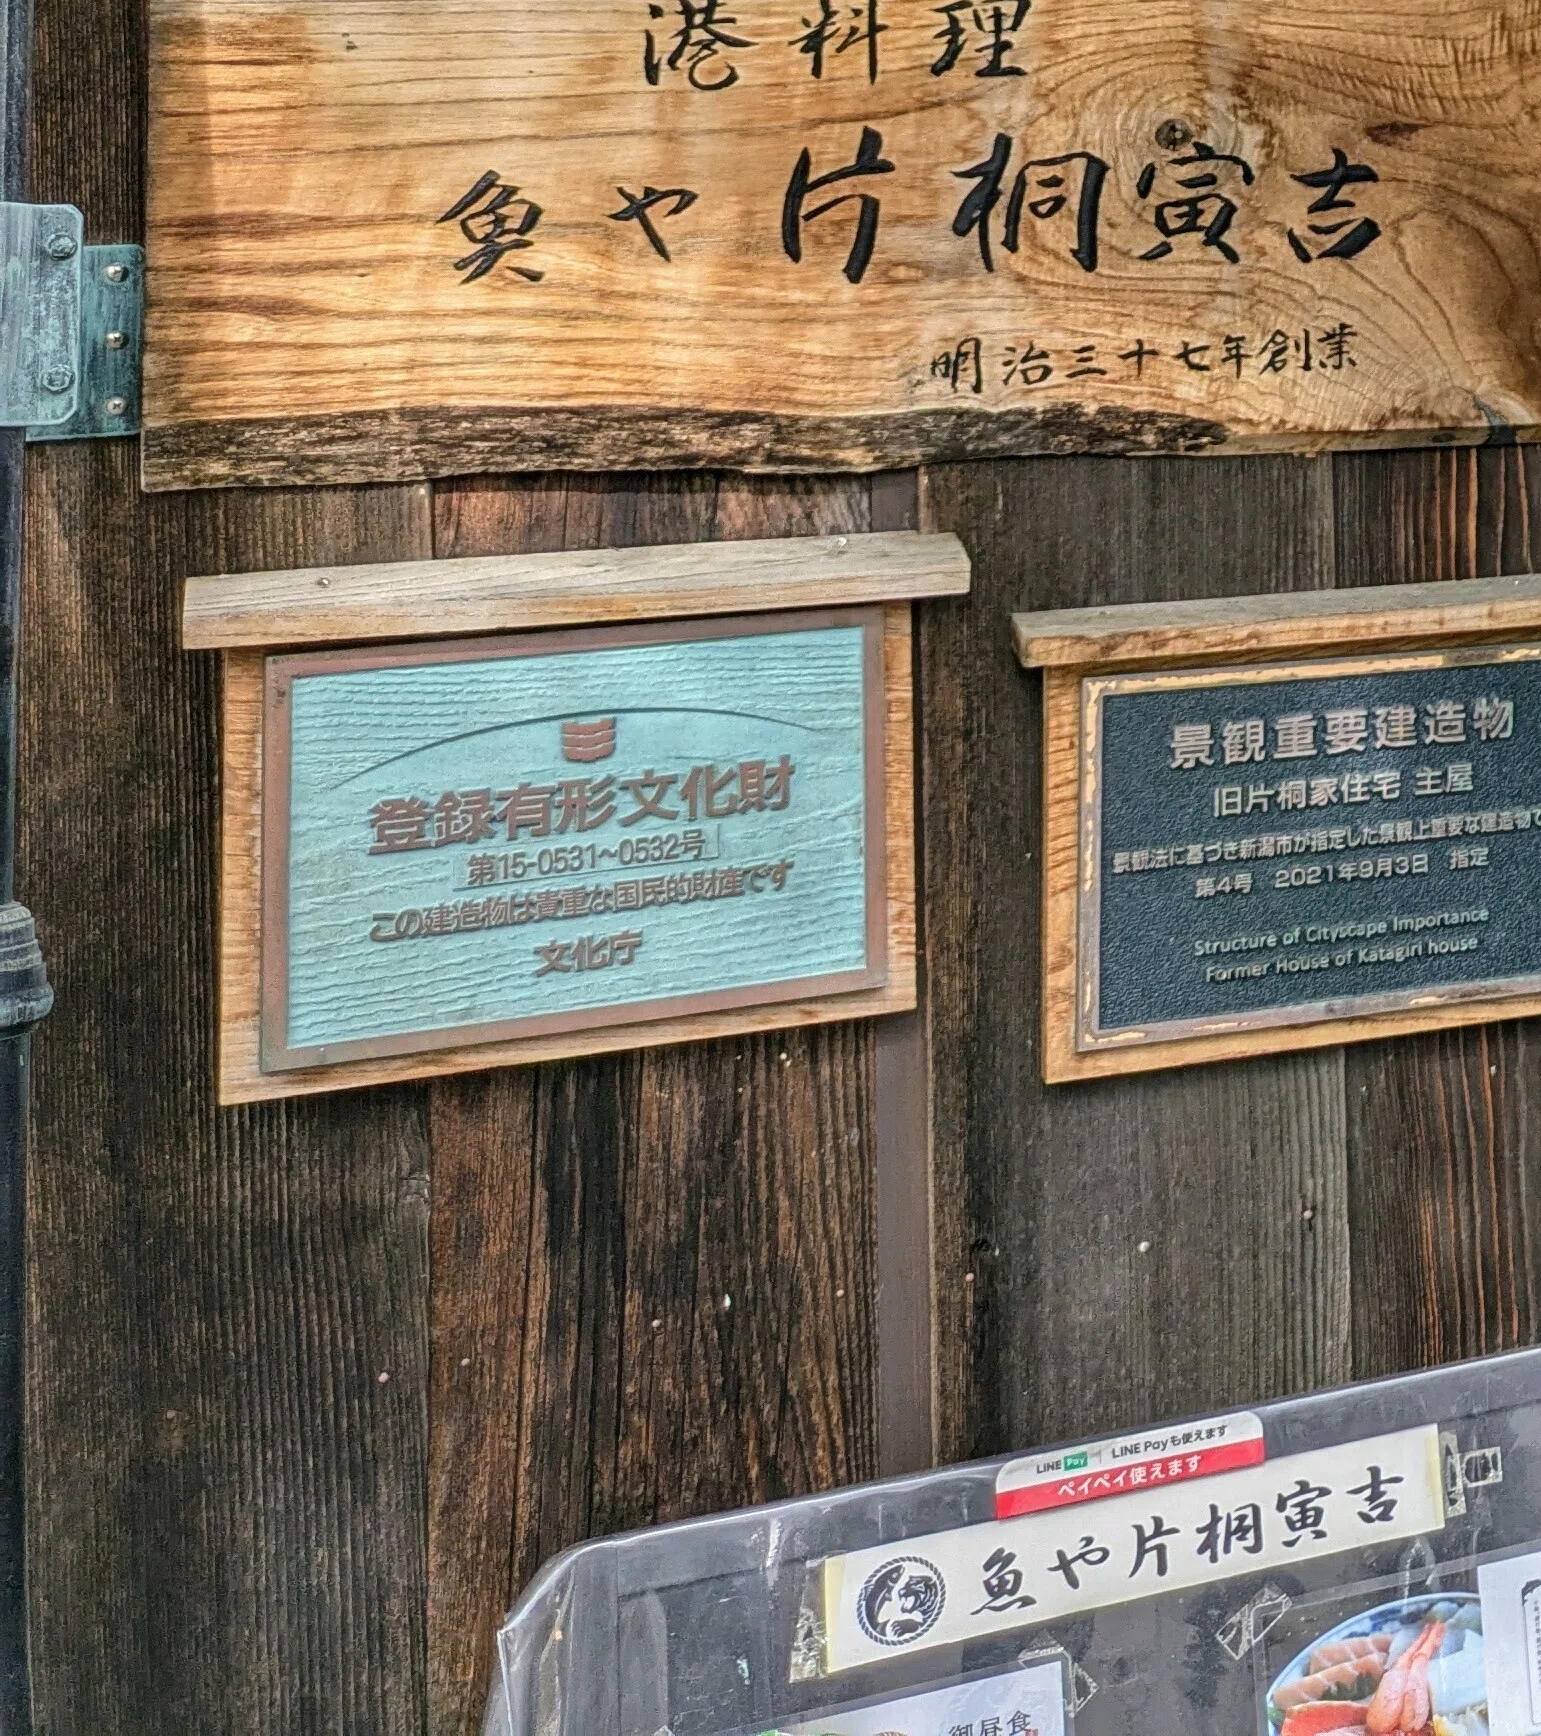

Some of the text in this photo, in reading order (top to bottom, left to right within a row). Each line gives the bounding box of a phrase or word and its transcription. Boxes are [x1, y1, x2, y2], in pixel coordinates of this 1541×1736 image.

[929, 321, 1360, 398] 明治三十七年創業
[1169, 697, 1515, 771] 景観重要建造物
[367, 755, 797, 857] 登録有形文化財
[1213, 763, 1474, 818] 旧片桐家住宅 主屋
[1195, 847, 1489, 900] 第4号 2021年9月3日 指定
[368, 861, 793, 943] この建造物は貴重な国民的財産です
[532, 929, 643, 978] 文化庁
[1194, 906, 1490, 958] Structure of Cityscape Importance
[1205, 934, 1478, 984] Former House of Katagiri house
[1036, 1457, 1085, 1474] LINE Pay
[1057, 1455, 1202, 1497] ペイペイ使えます
[1111, 1442, 1141, 1459] LINE
[968, 1466, 1407, 1617] 魚や片桐寅吉
